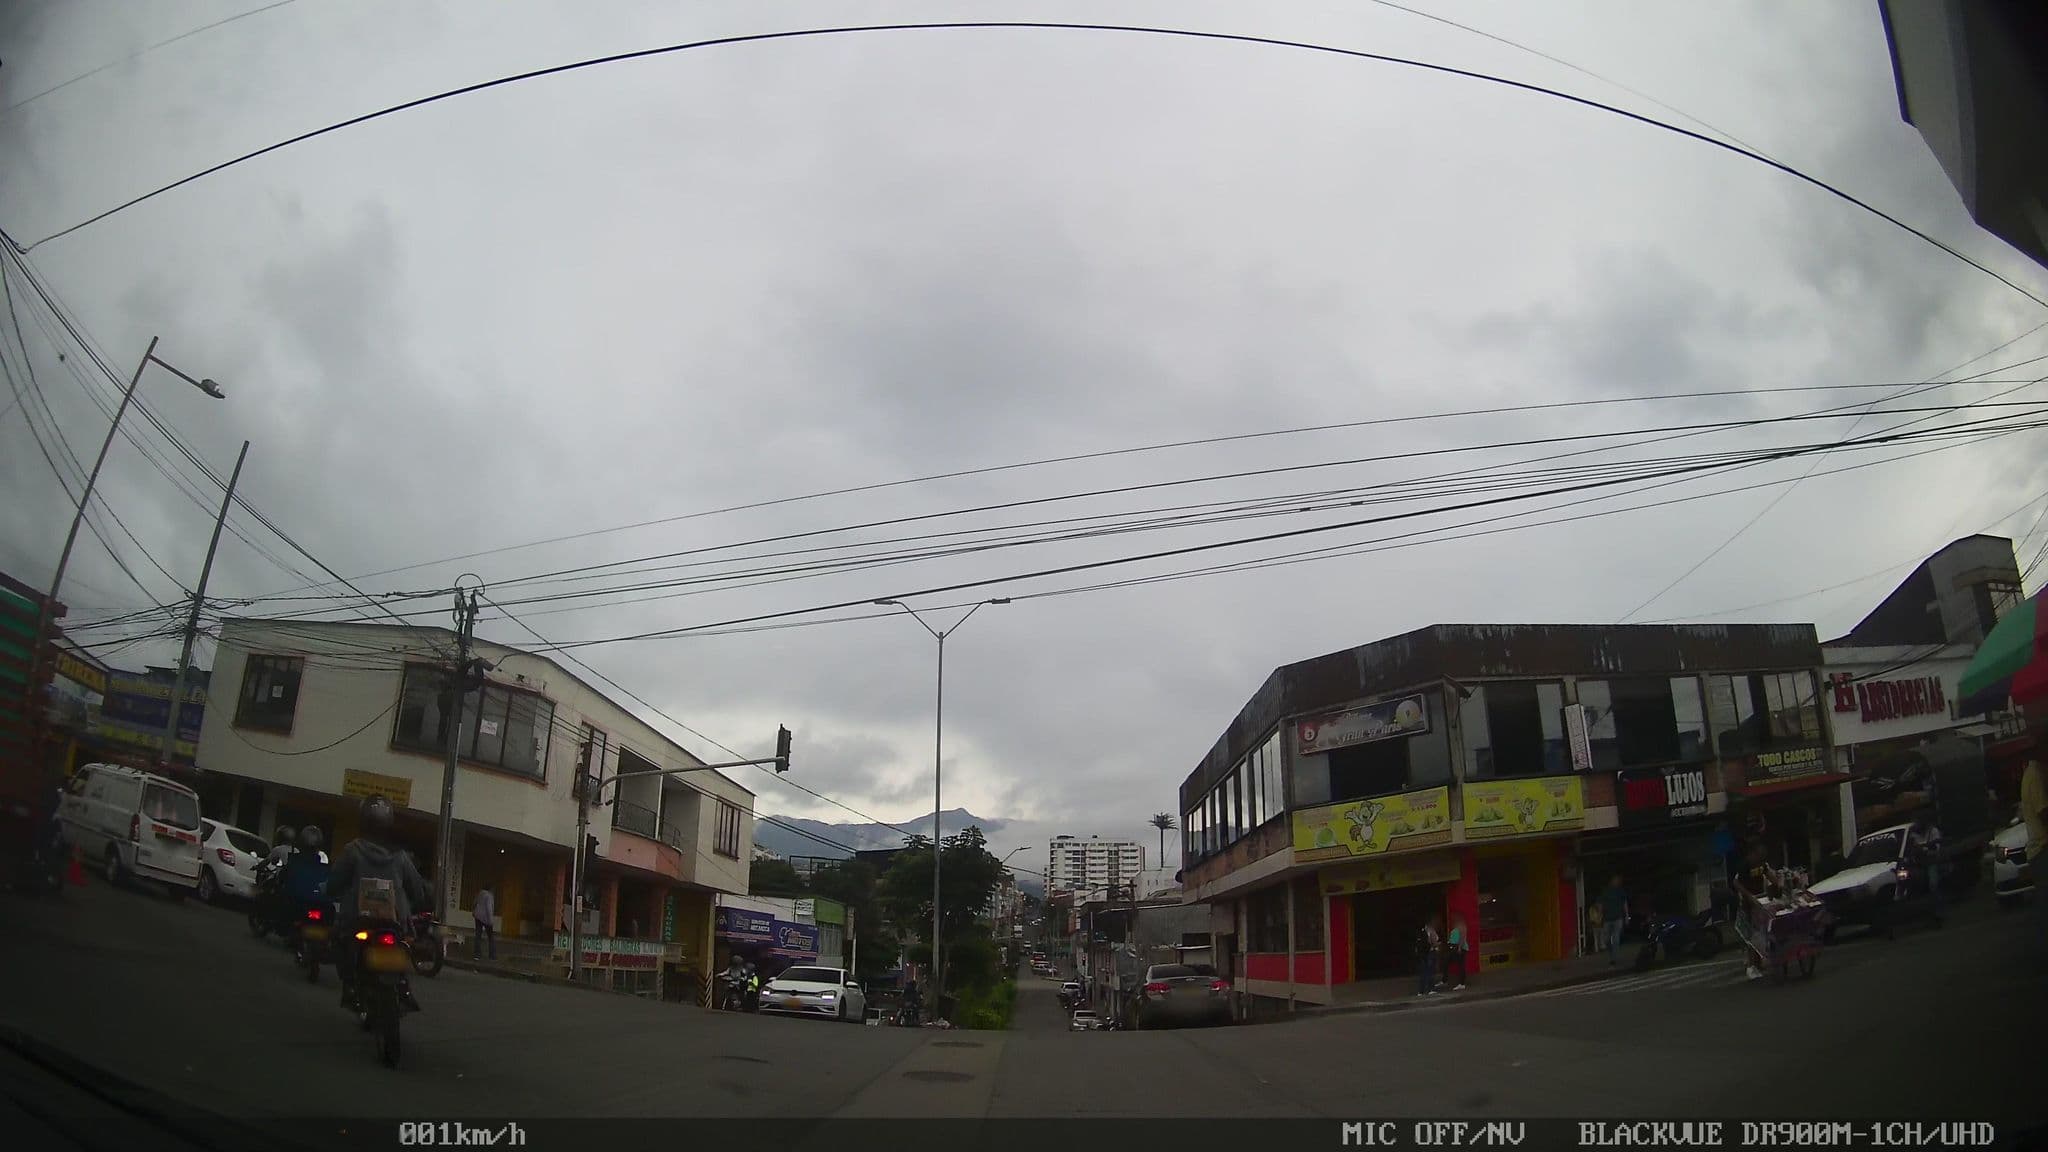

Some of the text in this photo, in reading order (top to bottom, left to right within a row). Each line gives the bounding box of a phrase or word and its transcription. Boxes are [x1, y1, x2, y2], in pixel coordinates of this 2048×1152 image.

[1757, 747, 1817, 768] TODO CASCOS
[1664, 770, 1705, 806] LUJOS
